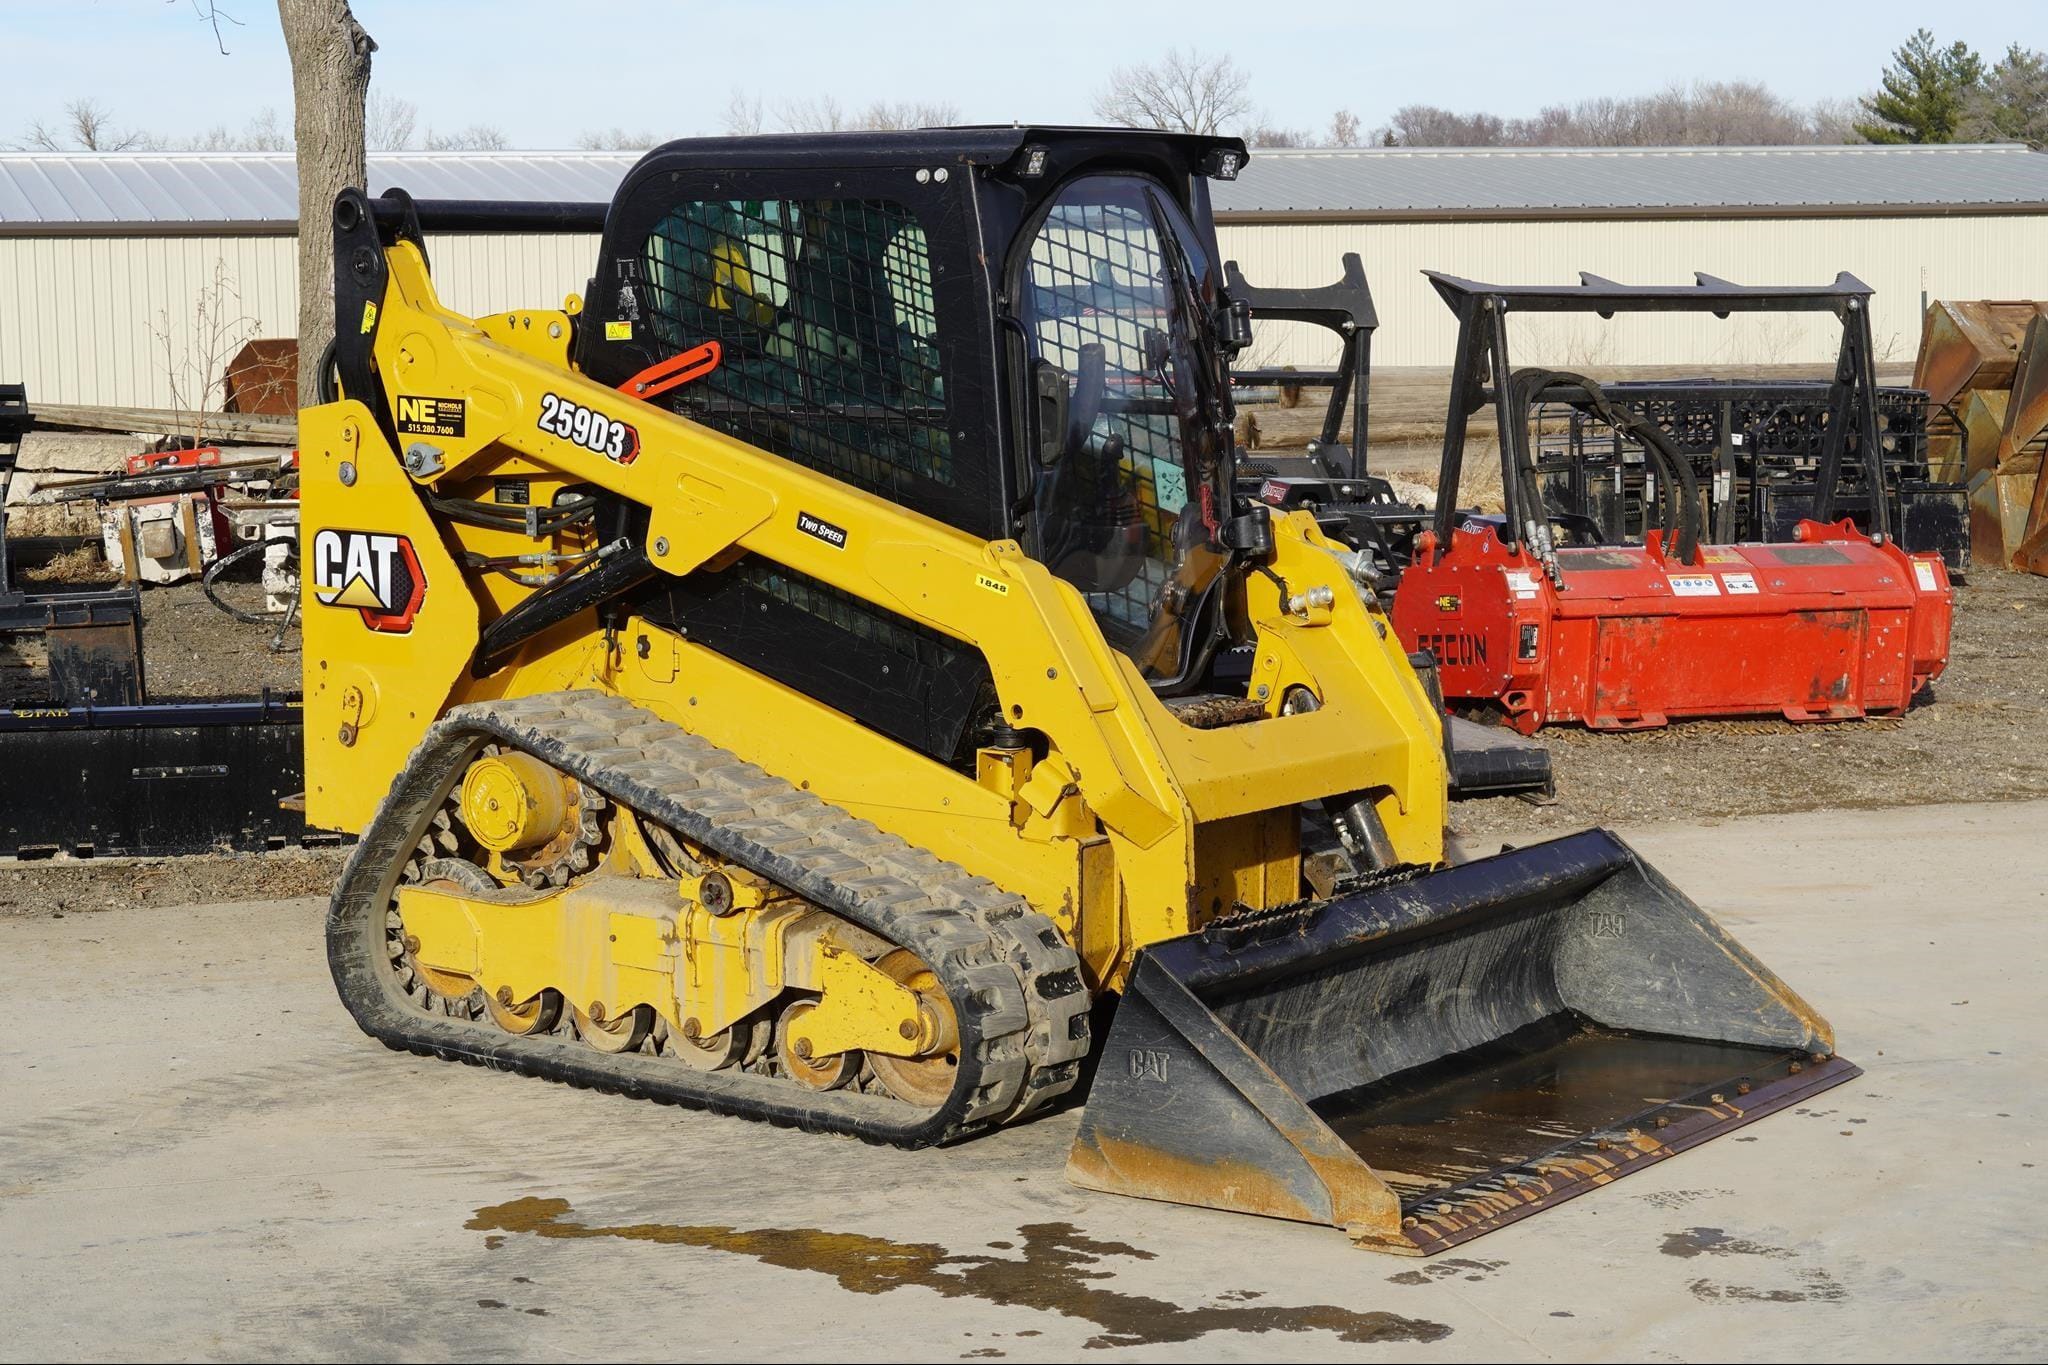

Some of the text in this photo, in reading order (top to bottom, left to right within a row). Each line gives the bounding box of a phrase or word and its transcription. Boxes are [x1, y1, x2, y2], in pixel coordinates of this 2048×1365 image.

[400, 398, 436, 423] NE
[407, 424, 454, 434] 515.280.7600
[538, 393, 626, 459] 259D3
[315, 530, 398, 609] CAT
[980, 577, 1007, 592] 1848
[1129, 1049, 1170, 1084] CAT
